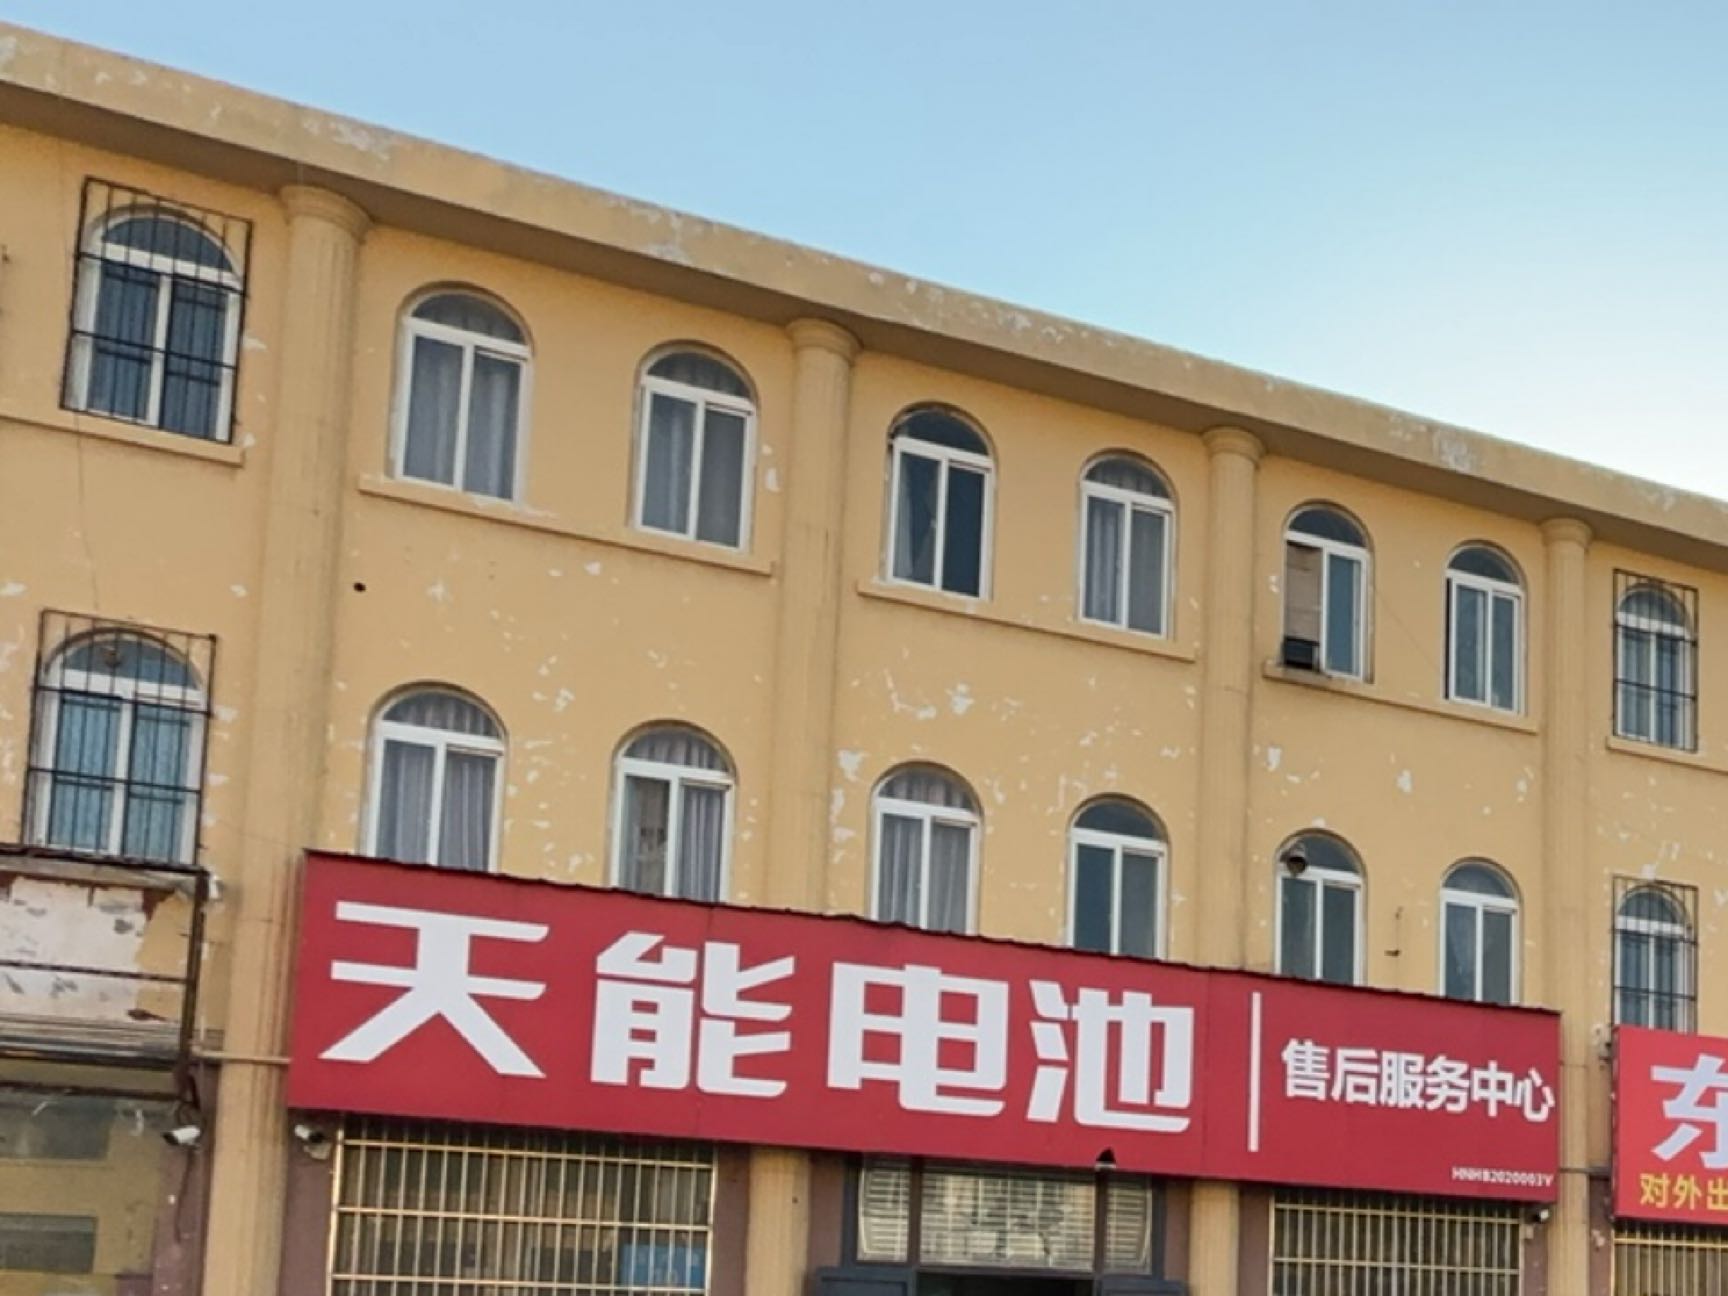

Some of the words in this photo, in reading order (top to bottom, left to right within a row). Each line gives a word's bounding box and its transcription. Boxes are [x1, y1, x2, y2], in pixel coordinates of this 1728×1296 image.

[319, 901, 1195, 1133] 天能电池
[1281, 1038, 1556, 1123] 售后服务中心
